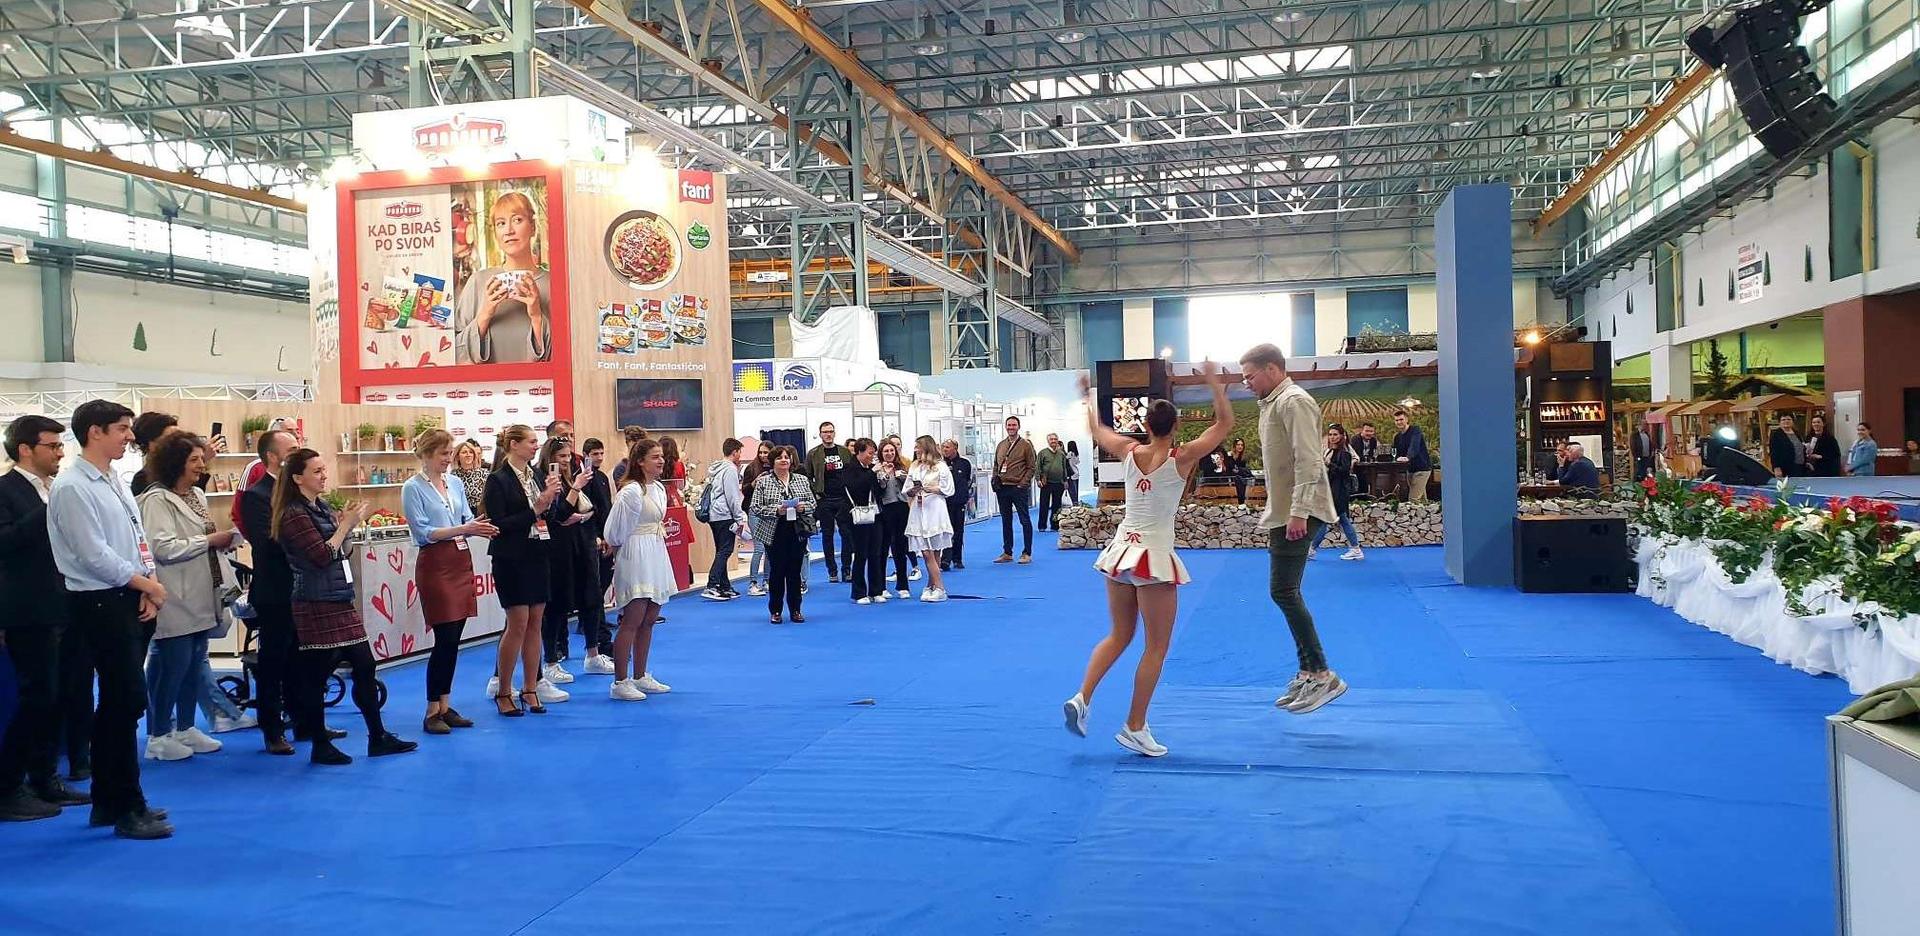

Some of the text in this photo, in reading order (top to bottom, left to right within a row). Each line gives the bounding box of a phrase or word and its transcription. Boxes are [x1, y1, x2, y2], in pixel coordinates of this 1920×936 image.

[681, 180, 712, 200] fant
[368, 217, 441, 238] KAD BIRAŠ
[375, 236, 435, 252] PO SVOM
[643, 400, 678, 409] SHARP
[745, 395, 780, 403] Commerce
